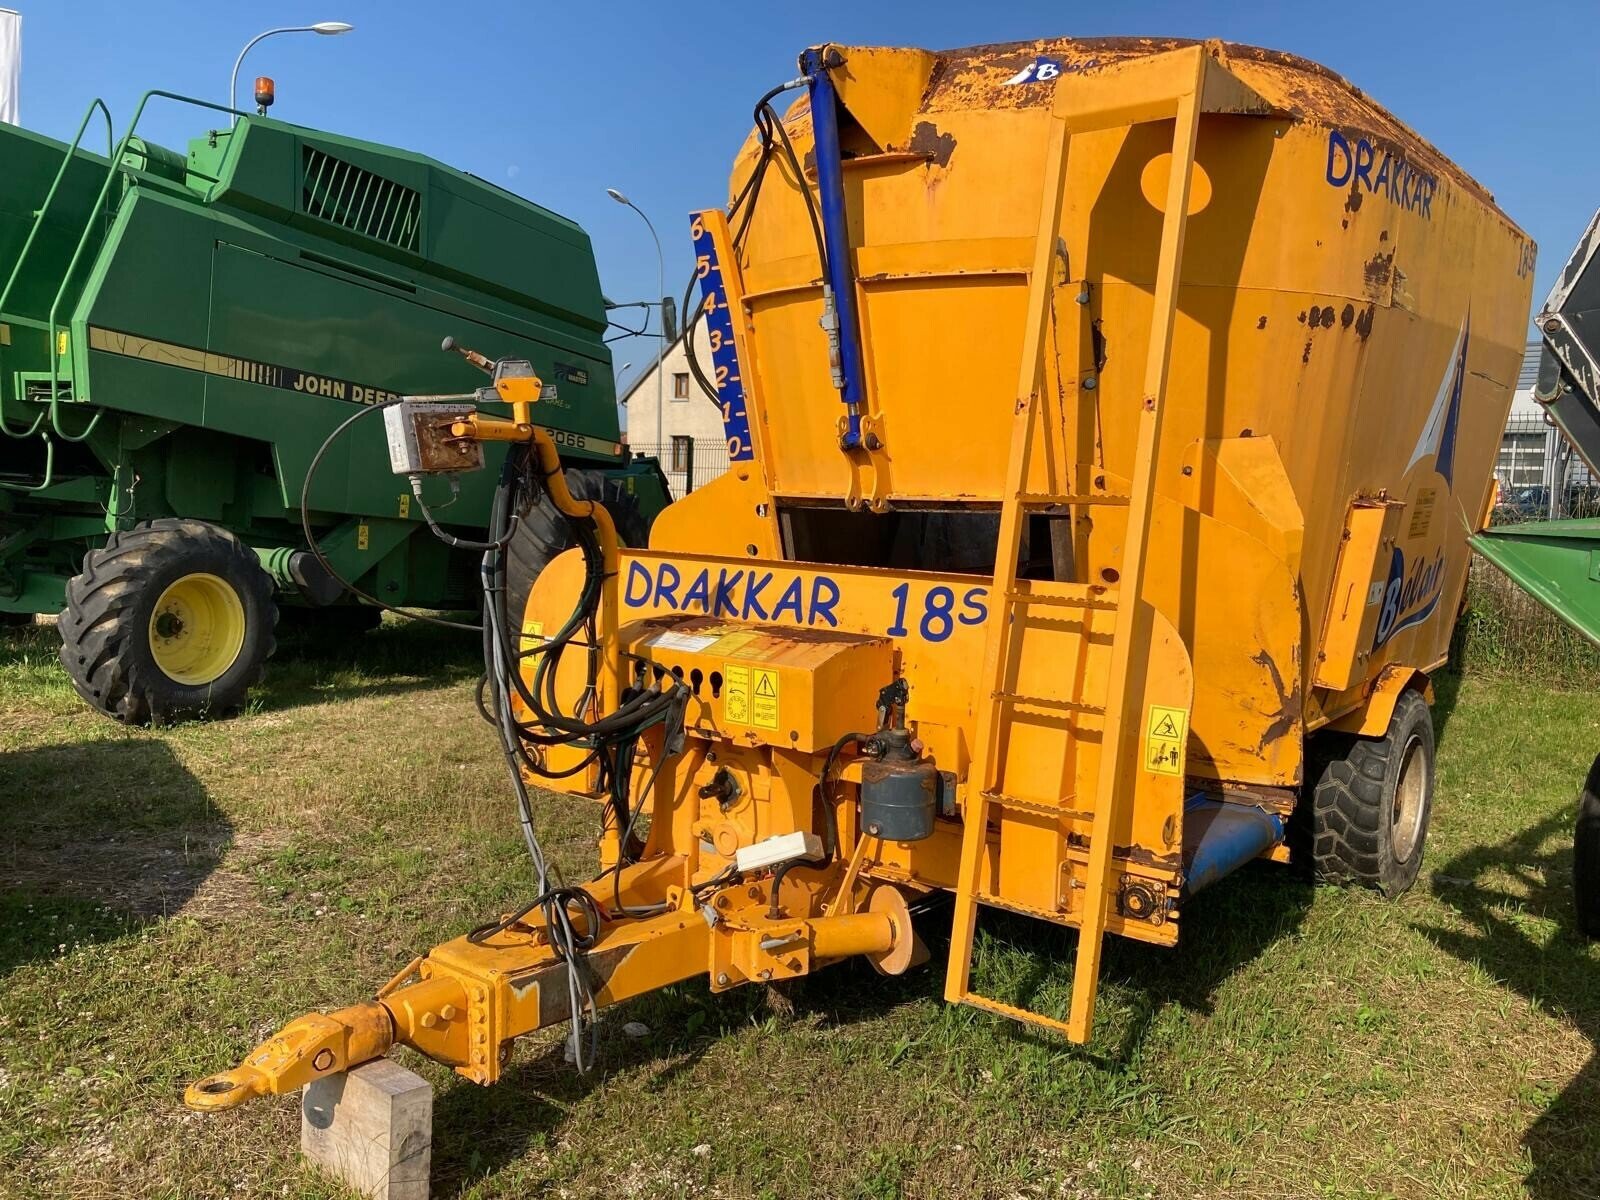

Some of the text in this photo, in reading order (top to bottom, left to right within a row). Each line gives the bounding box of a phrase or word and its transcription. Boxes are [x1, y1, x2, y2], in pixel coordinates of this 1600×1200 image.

[1326, 129, 1437, 221] DRAKKAR
[691, 217, 703, 240] 6
[697, 255, 710, 279] 5
[704, 292, 716, 315] 4
[710, 330, 722, 352] 3
[716, 366, 728, 388] 2
[294, 374, 402, 405] JOHN DEER
[722, 401, 731, 422] 1
[728, 436, 741, 457] 0
[624, 559, 840, 628] DRAKKAR
